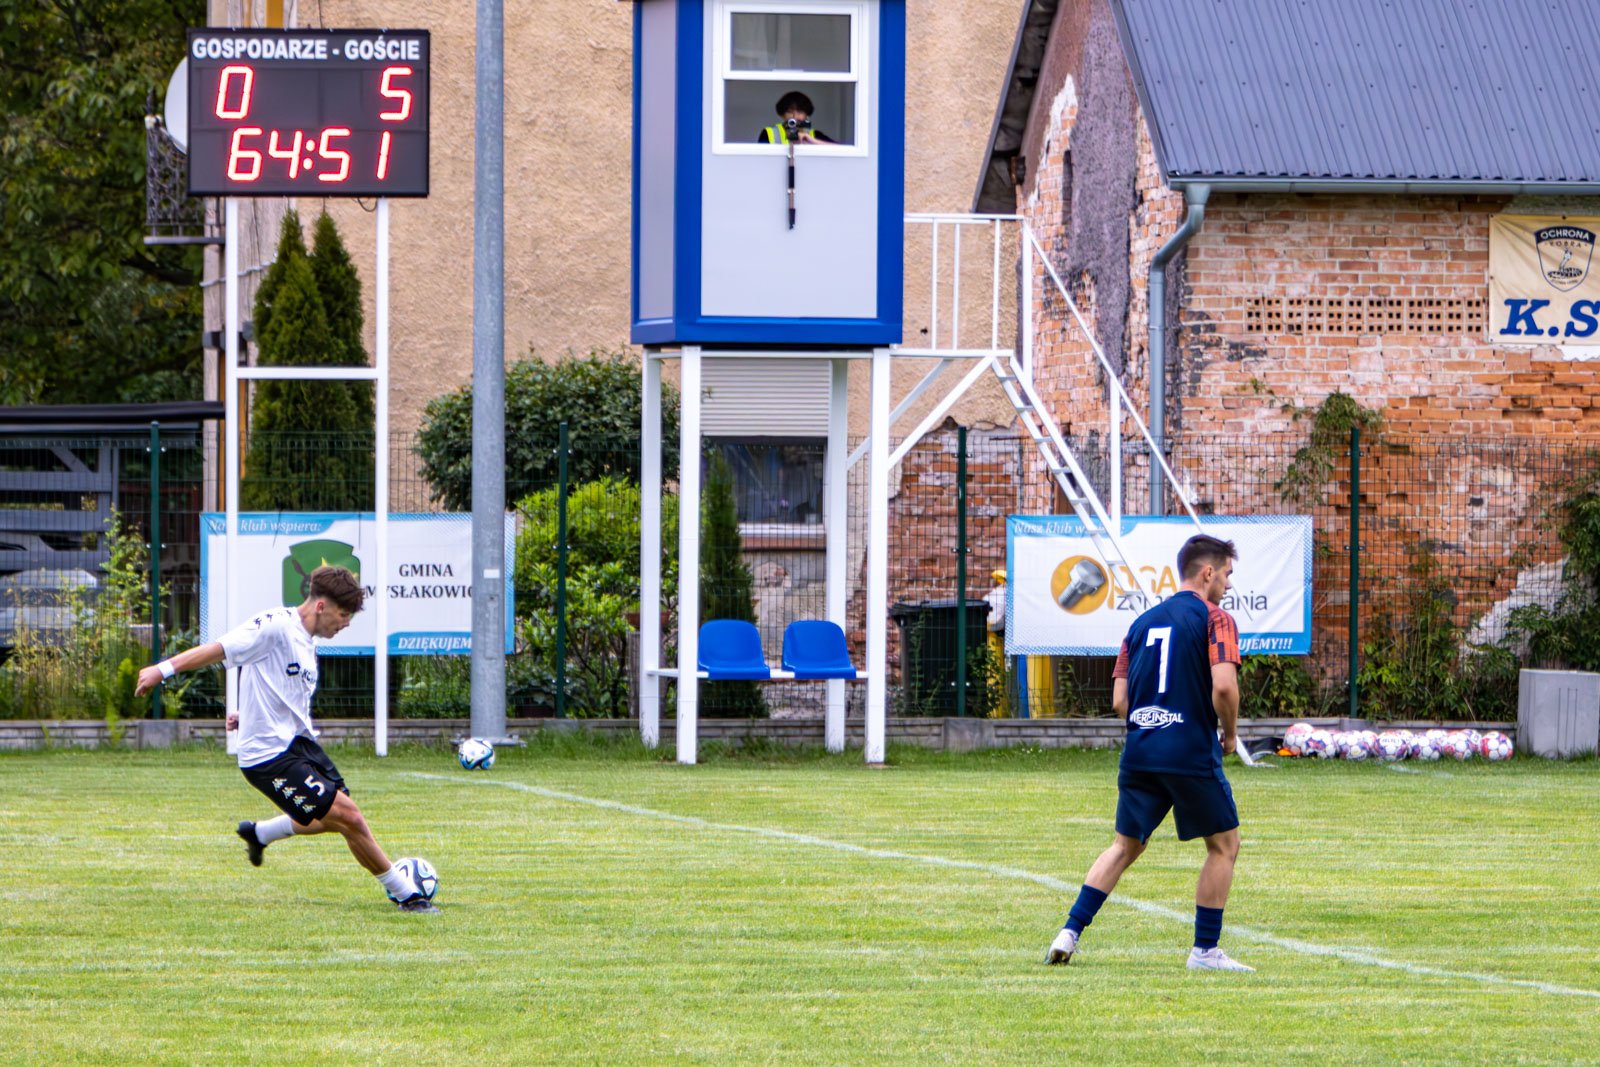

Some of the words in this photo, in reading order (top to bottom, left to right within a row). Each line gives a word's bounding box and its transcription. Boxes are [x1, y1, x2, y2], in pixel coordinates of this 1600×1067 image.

[192, 38, 328, 59] GOSPODARZE
[344, 36, 420, 60] GOŚCIE
[215, 65, 254, 119] 0
[379, 66, 412, 121] 5
[1540, 229, 1590, 241] OCHRONA
[240, 519, 267, 532] klub
[1014, 521, 1043, 534] Nasz
[1045, 521, 1073, 534] klub
[398, 563, 454, 578] GMINA
[398, 637, 472, 651] DZIĘKUJEM
[1239, 637, 1294, 653] UJEMY!!!
[1146, 626, 1173, 693] 7
[303, 774, 325, 797] 5
